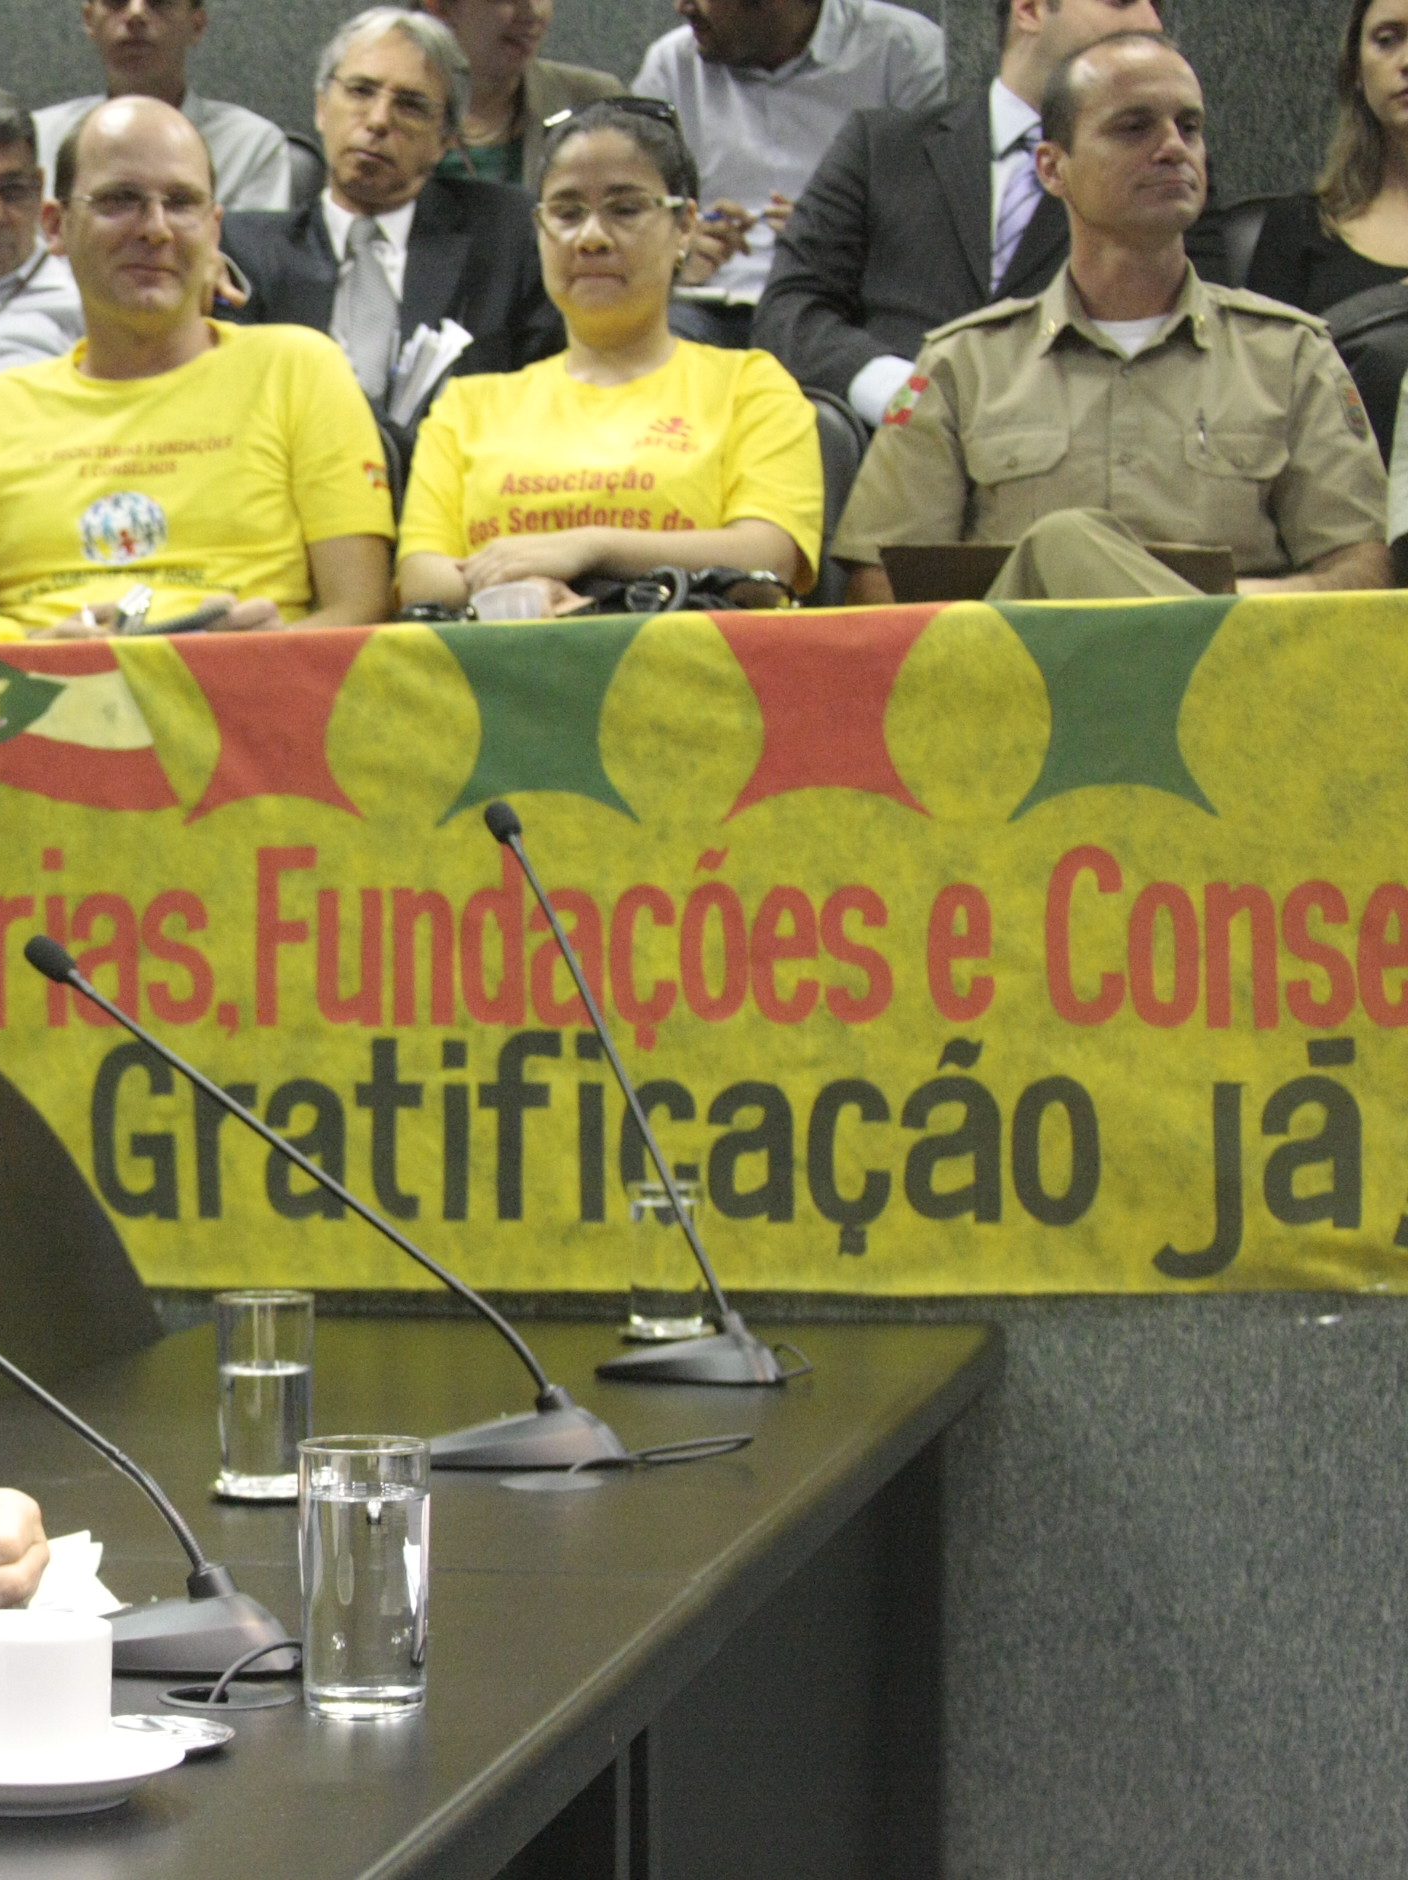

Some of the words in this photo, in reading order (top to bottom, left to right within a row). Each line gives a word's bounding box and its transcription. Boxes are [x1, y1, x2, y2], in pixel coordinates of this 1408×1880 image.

[500, 467, 656, 497] Associação
[508, 501, 652, 534] Servidores
[254, 836, 893, 1051] Fundações
[925, 881, 996, 1023] e
[1043, 843, 1408, 1030] Conse
[90, 1029, 1102, 1258] Gratificação
